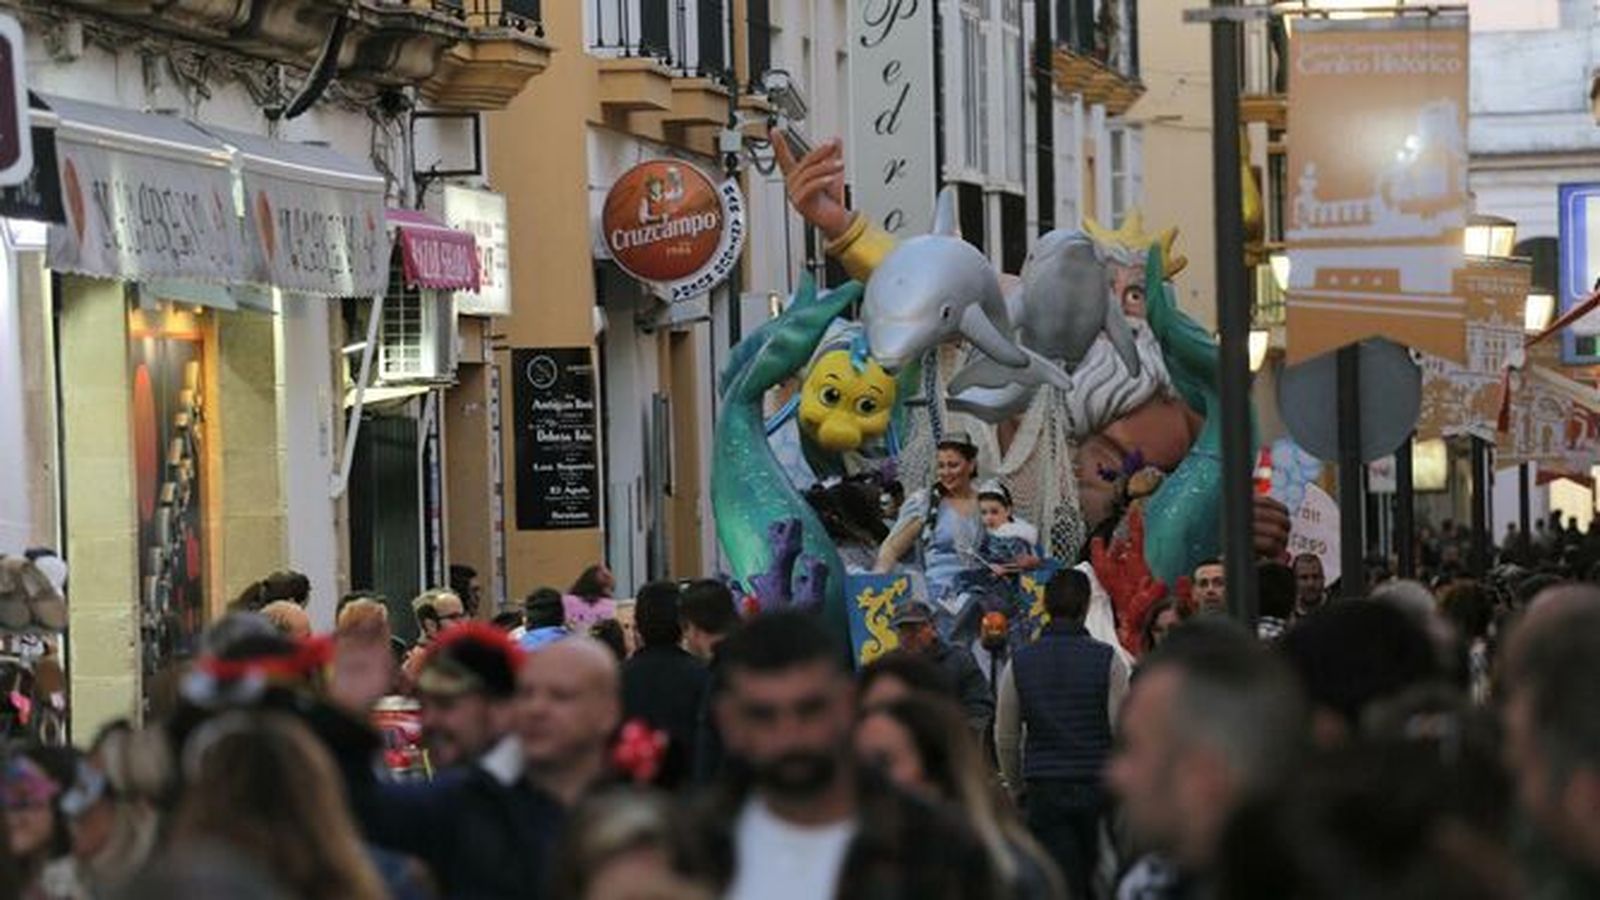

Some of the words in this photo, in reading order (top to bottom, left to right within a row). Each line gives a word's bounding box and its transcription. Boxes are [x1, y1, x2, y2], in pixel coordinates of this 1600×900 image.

[1296, 55, 1370, 75] Centro
[860, 0, 918, 234] Pedro
[611, 212, 716, 251] Cruzcampo
